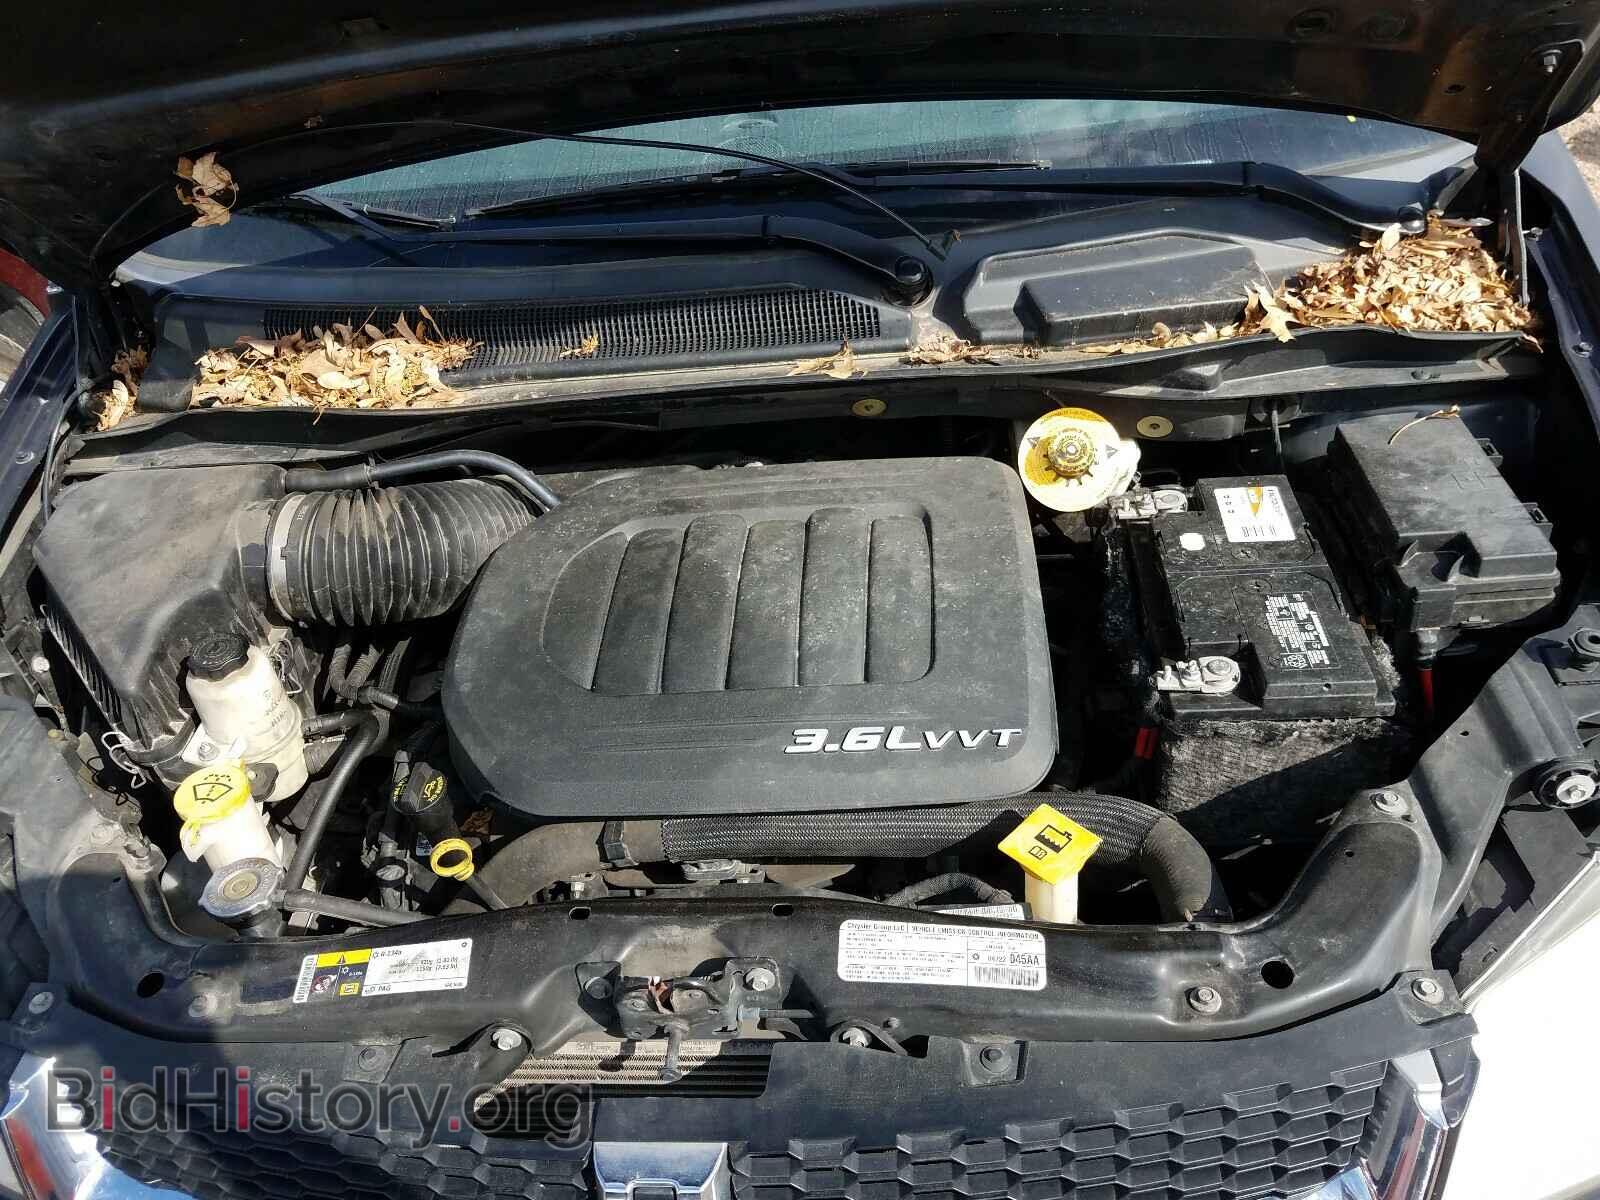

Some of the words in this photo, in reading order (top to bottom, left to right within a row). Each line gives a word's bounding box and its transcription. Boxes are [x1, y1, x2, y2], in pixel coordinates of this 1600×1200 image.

[847, 922, 871, 930] Chrysler
[912, 925, 935, 933] VEHICLE
[968, 928, 994, 936] CONTROL
[997, 931, 1039, 939] INFORMATION
